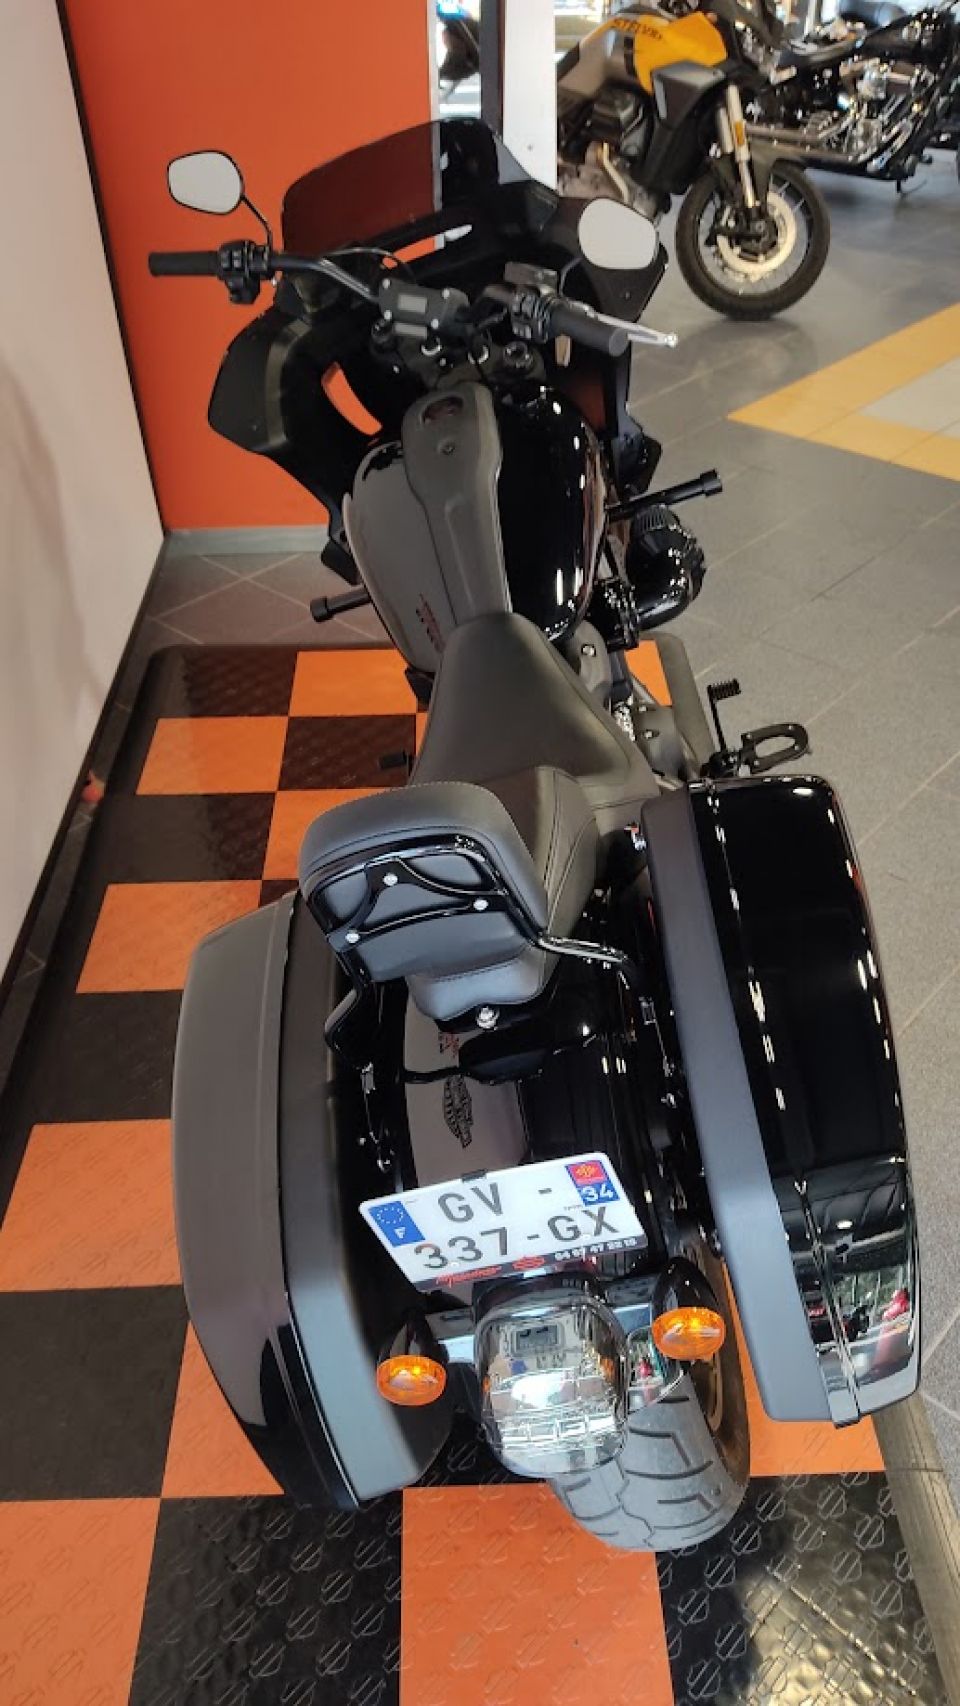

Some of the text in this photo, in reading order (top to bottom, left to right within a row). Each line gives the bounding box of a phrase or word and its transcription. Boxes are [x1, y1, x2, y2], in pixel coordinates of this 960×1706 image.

[581, 1183, 615, 1202] 34
[438, 1182, 504, 1224] GV
[393, 1226, 406, 1239] F
